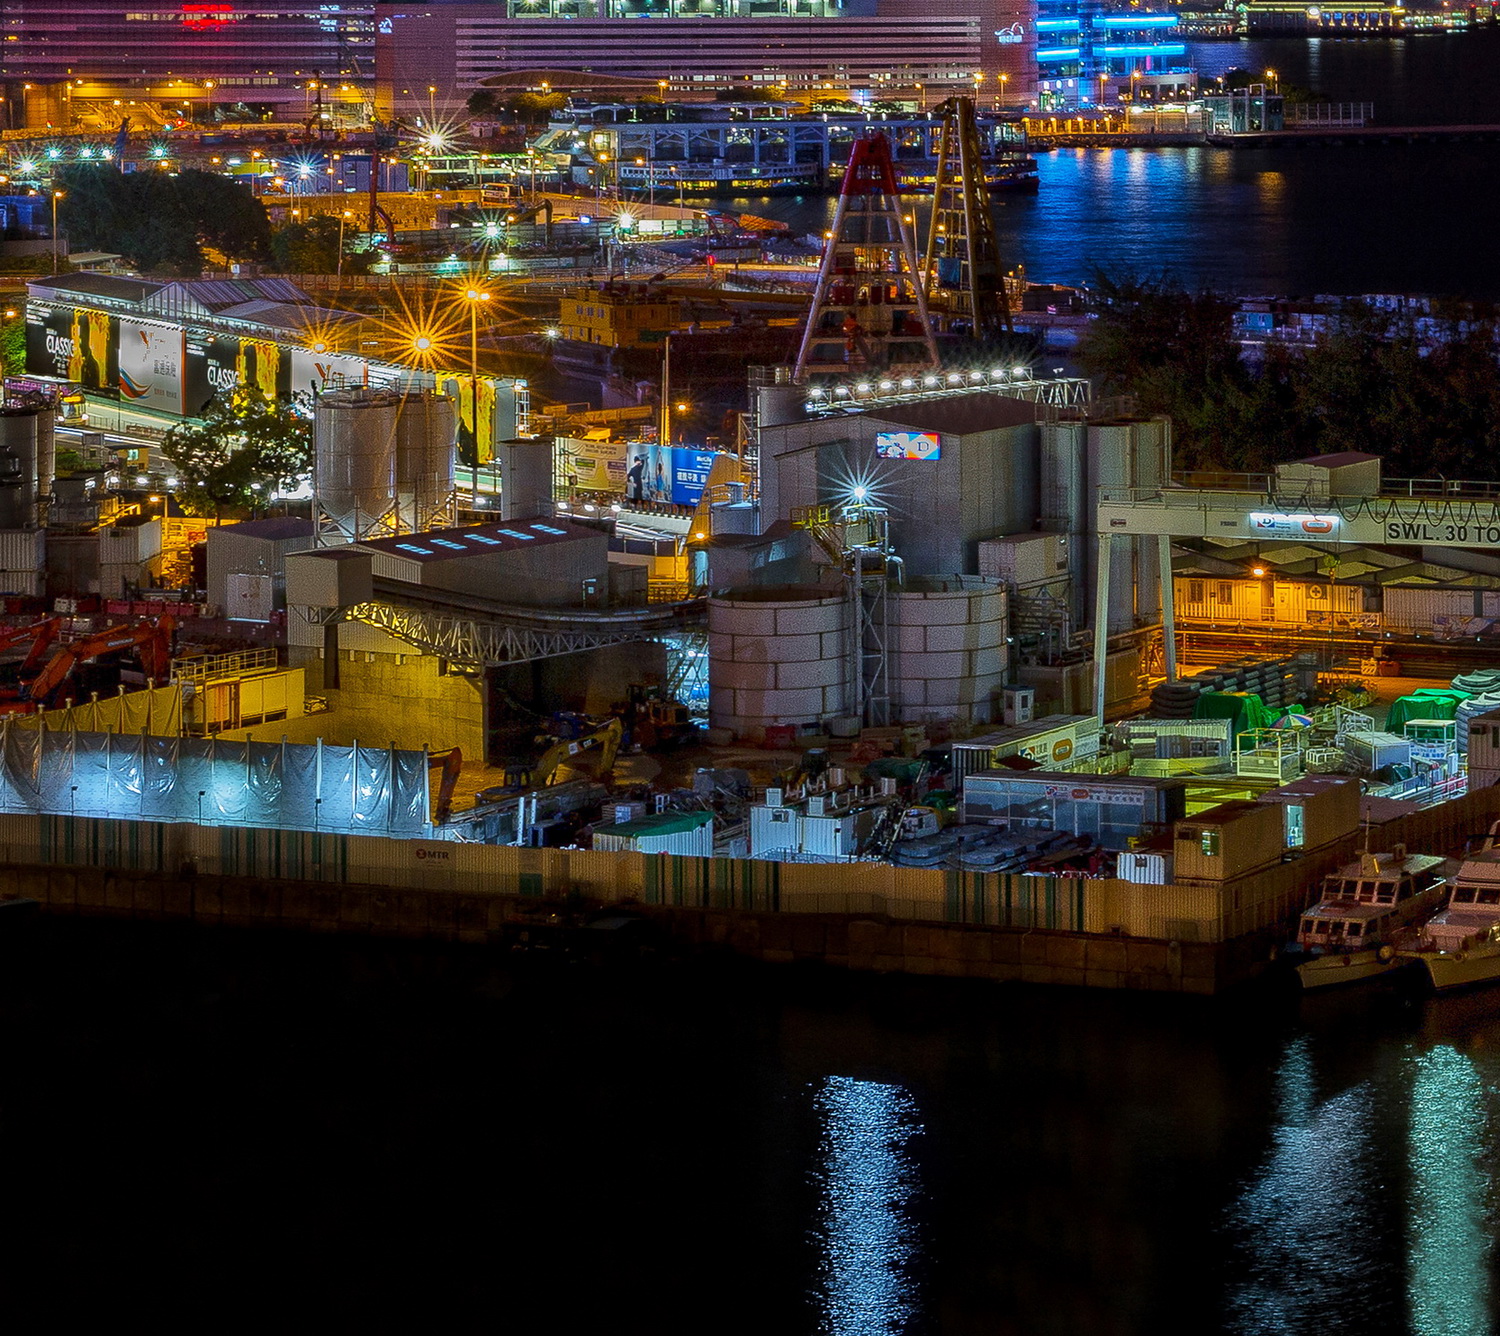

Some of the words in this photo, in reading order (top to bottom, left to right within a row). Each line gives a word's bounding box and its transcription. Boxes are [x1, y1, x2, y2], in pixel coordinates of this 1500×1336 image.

[1388, 523, 1440, 541] SWL.
[1445, 525, 1467, 541] 30
[427, 850, 449, 859] MTR
